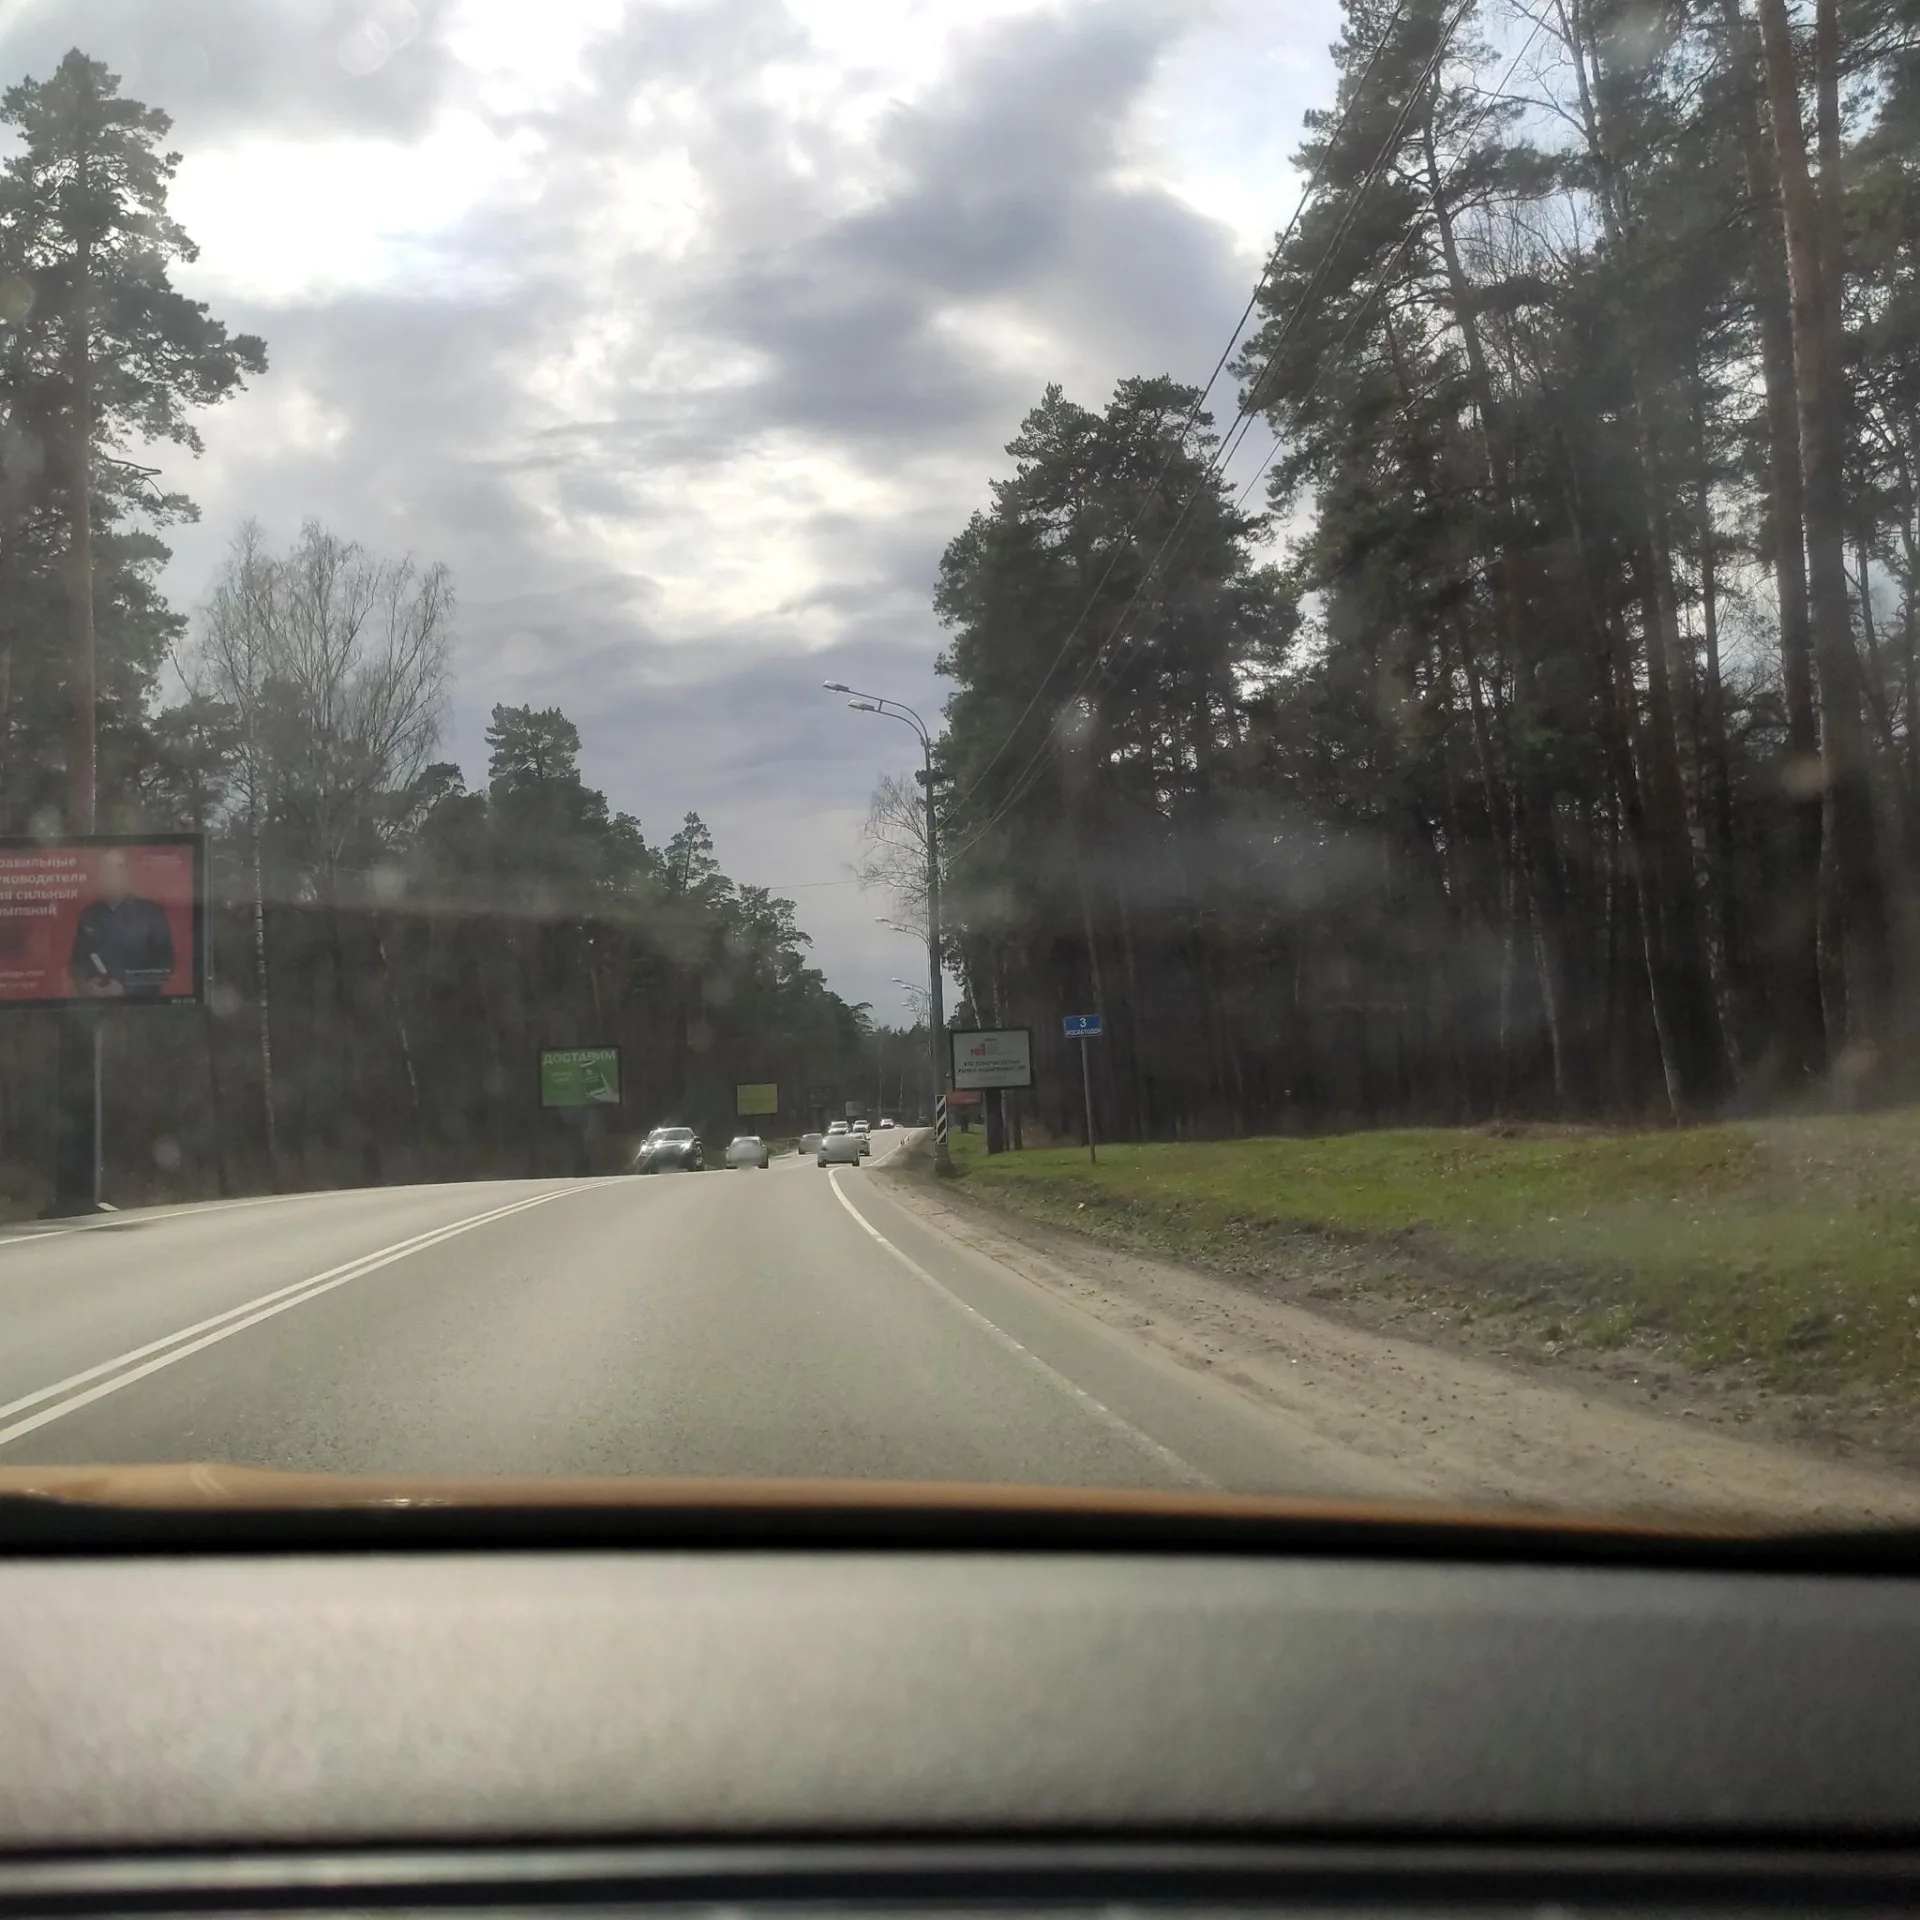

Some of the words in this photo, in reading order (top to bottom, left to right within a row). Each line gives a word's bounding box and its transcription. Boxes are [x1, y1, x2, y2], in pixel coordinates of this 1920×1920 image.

[0, 873, 88, 885] ководители
[16, 888, 79, 900] сильных
[0, 904, 57, 916] мпаний
[1079, 1017, 1088, 1028] 3
[542, 1050, 616, 1065] ДОСТАВИМ
